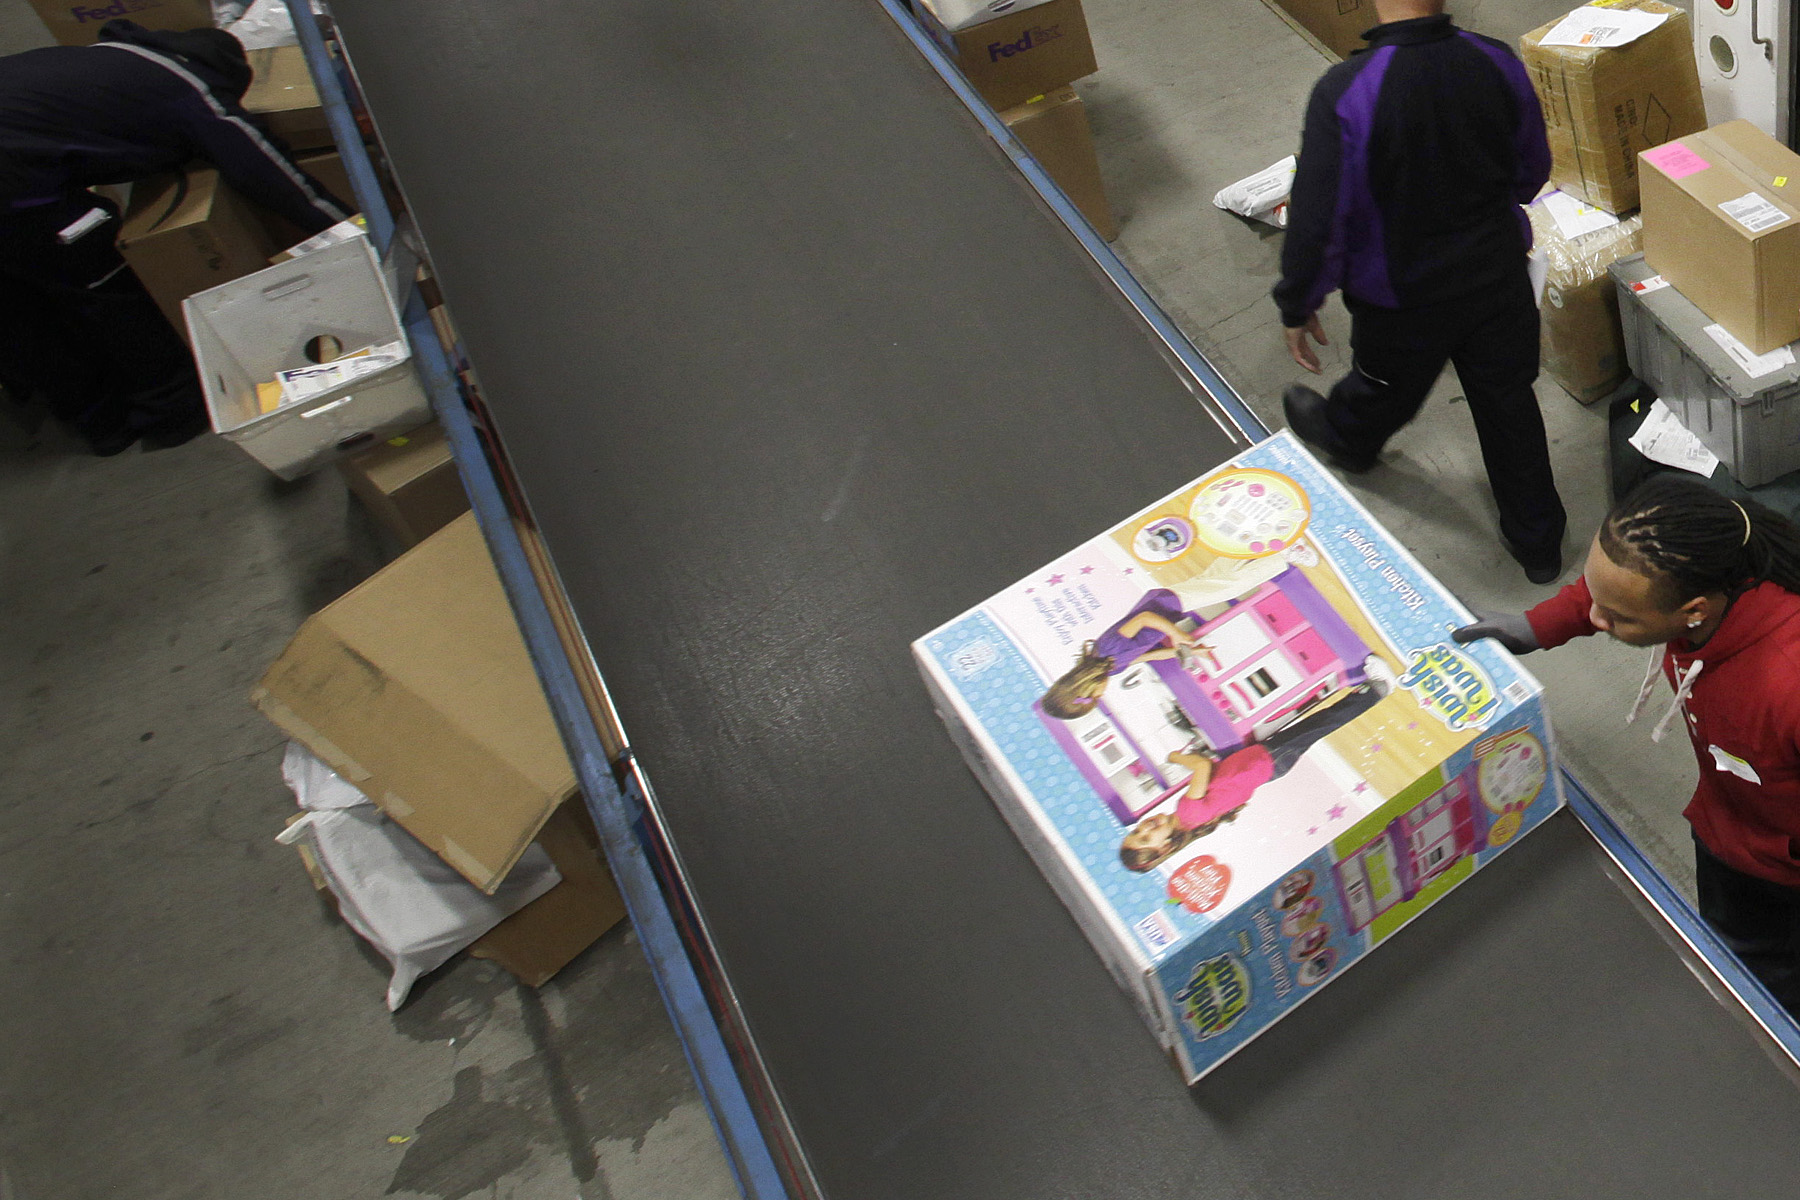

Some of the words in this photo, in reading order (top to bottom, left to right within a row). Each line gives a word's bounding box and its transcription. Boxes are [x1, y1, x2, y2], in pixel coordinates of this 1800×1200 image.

[987, 23, 1065, 63] FedEx
[1337, 523, 1391, 571] Playset
[1373, 563, 1427, 613] Kitchen
[1400, 656, 1468, 730] wish
[1428, 645, 1488, 707] was
[1264, 949, 1293, 1001] Kitchen
